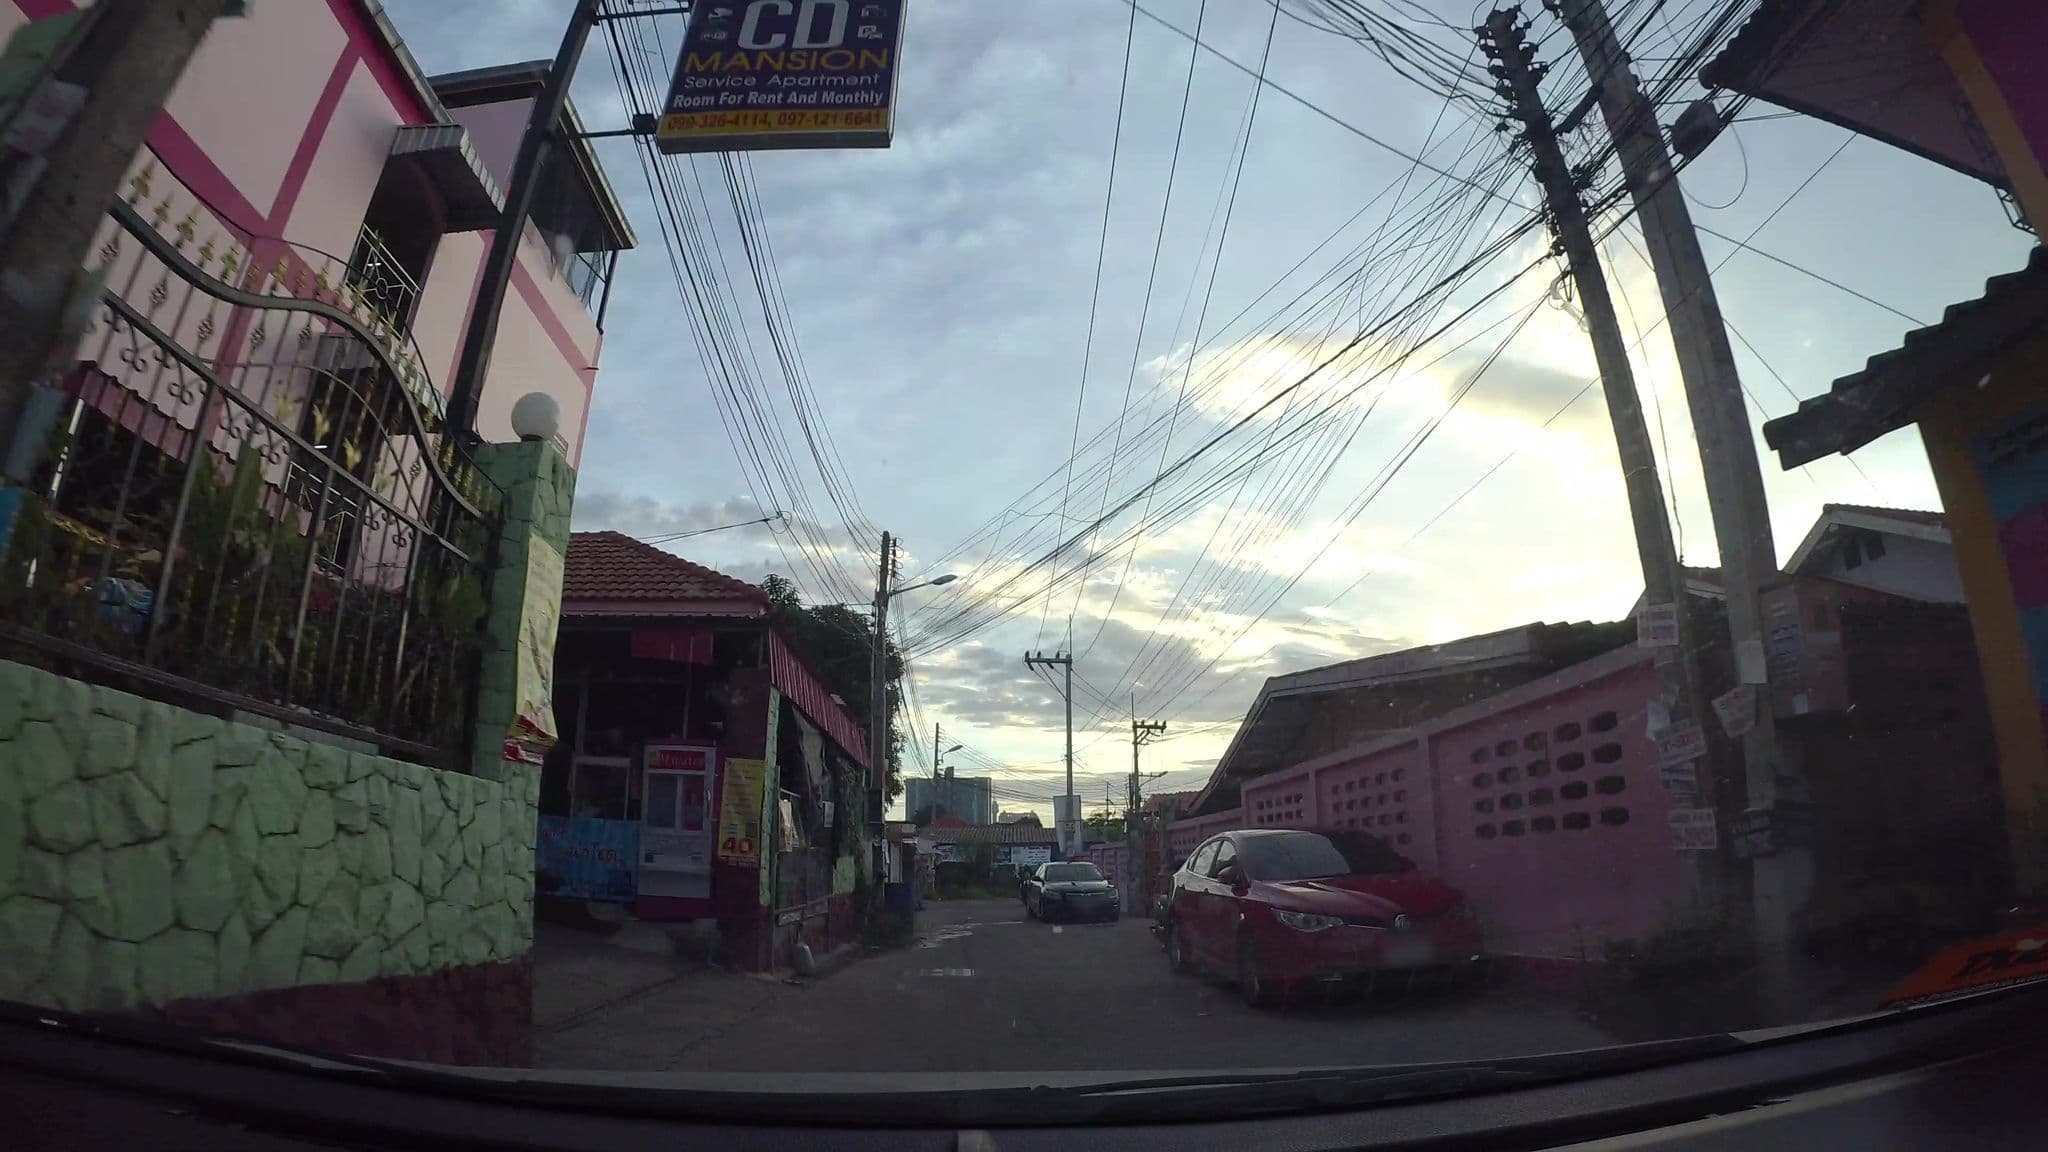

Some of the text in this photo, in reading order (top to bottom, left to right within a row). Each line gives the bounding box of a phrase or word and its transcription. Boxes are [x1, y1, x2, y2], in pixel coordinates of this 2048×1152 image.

[738, 0, 849, 49] CD
[684, 48, 888, 73] MANSION
[684, 72, 880, 89] Service Apartment
[674, 90, 883, 108] Room For Rent And Monthly
